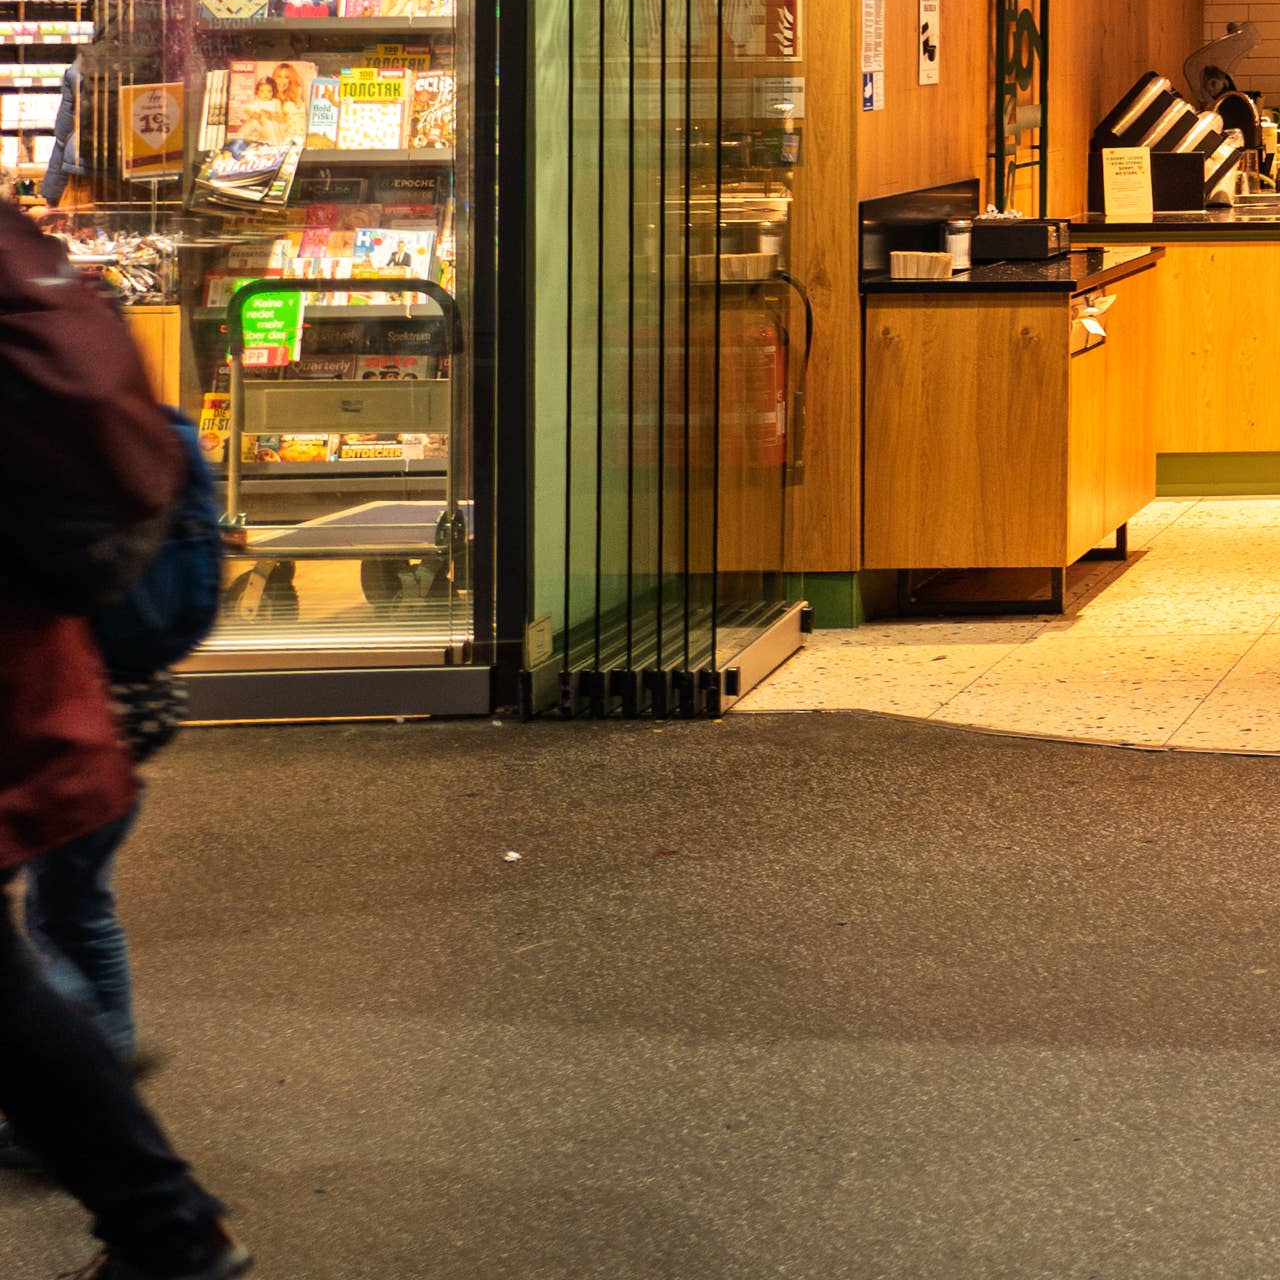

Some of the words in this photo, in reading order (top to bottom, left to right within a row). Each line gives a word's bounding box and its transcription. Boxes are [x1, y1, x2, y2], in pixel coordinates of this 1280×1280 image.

[343, 82, 401, 97] ТОЛСТЯК
[394, 178, 436, 188] EPOCHE
[388, 331, 432, 342] Spektrum
[365, 355, 418, 368] arte
[341, 447, 402, 459] ENTDECKER
